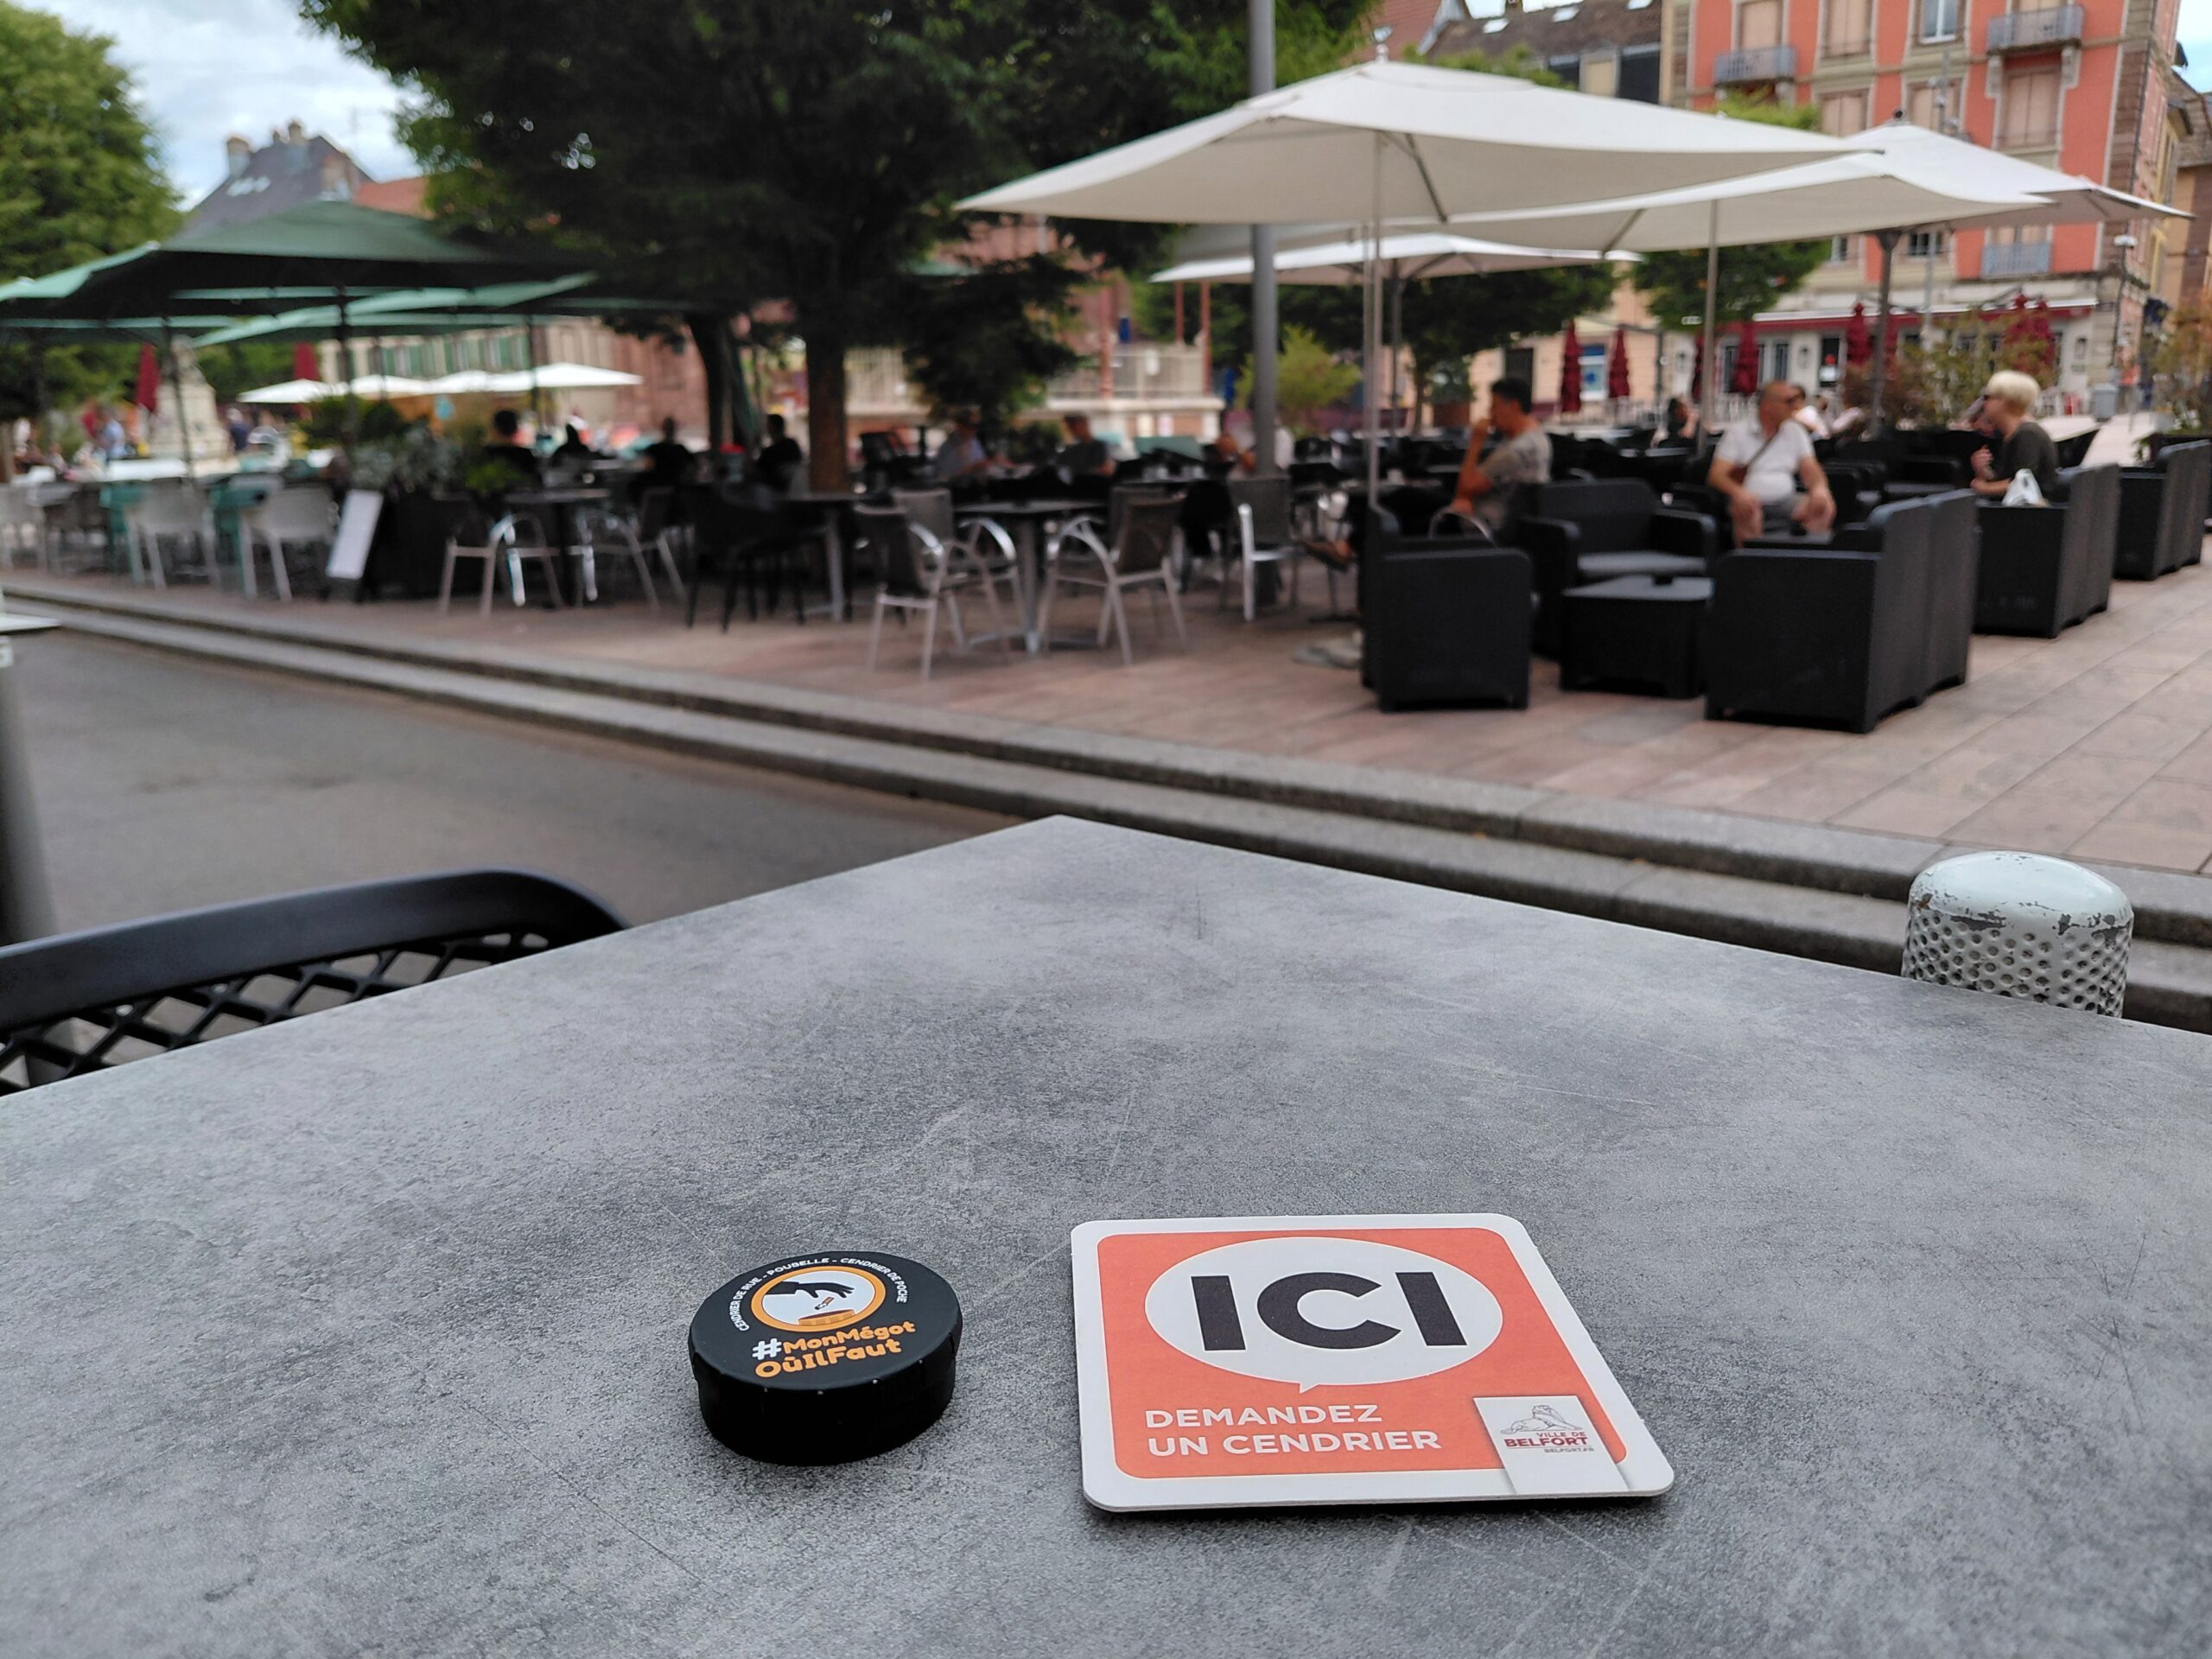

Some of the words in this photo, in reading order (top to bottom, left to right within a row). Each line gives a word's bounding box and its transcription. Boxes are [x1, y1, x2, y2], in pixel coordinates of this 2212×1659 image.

[766, 1257, 830, 1276] POUBELLE
[840, 1257, 892, 1274] CENDRIER
[887, 1270, 902, 1282] DE
[741, 1277, 763, 1290] RUE
[894, 1280, 908, 1304] POCHE
[733, 1291, 747, 1300] DE
[729, 1300, 750, 1332] CENDRIER
[1190, 1271, 1469, 1351] ICI
[752, 1320, 917, 1361] #MonMégot
[1144, 1403, 1383, 1429] DEMANDEZ
[1147, 1435, 1210, 1458] UN
[1222, 1430, 1442, 1455] CENDRIER
[1504, 1437, 1588, 1447] BELFORT
